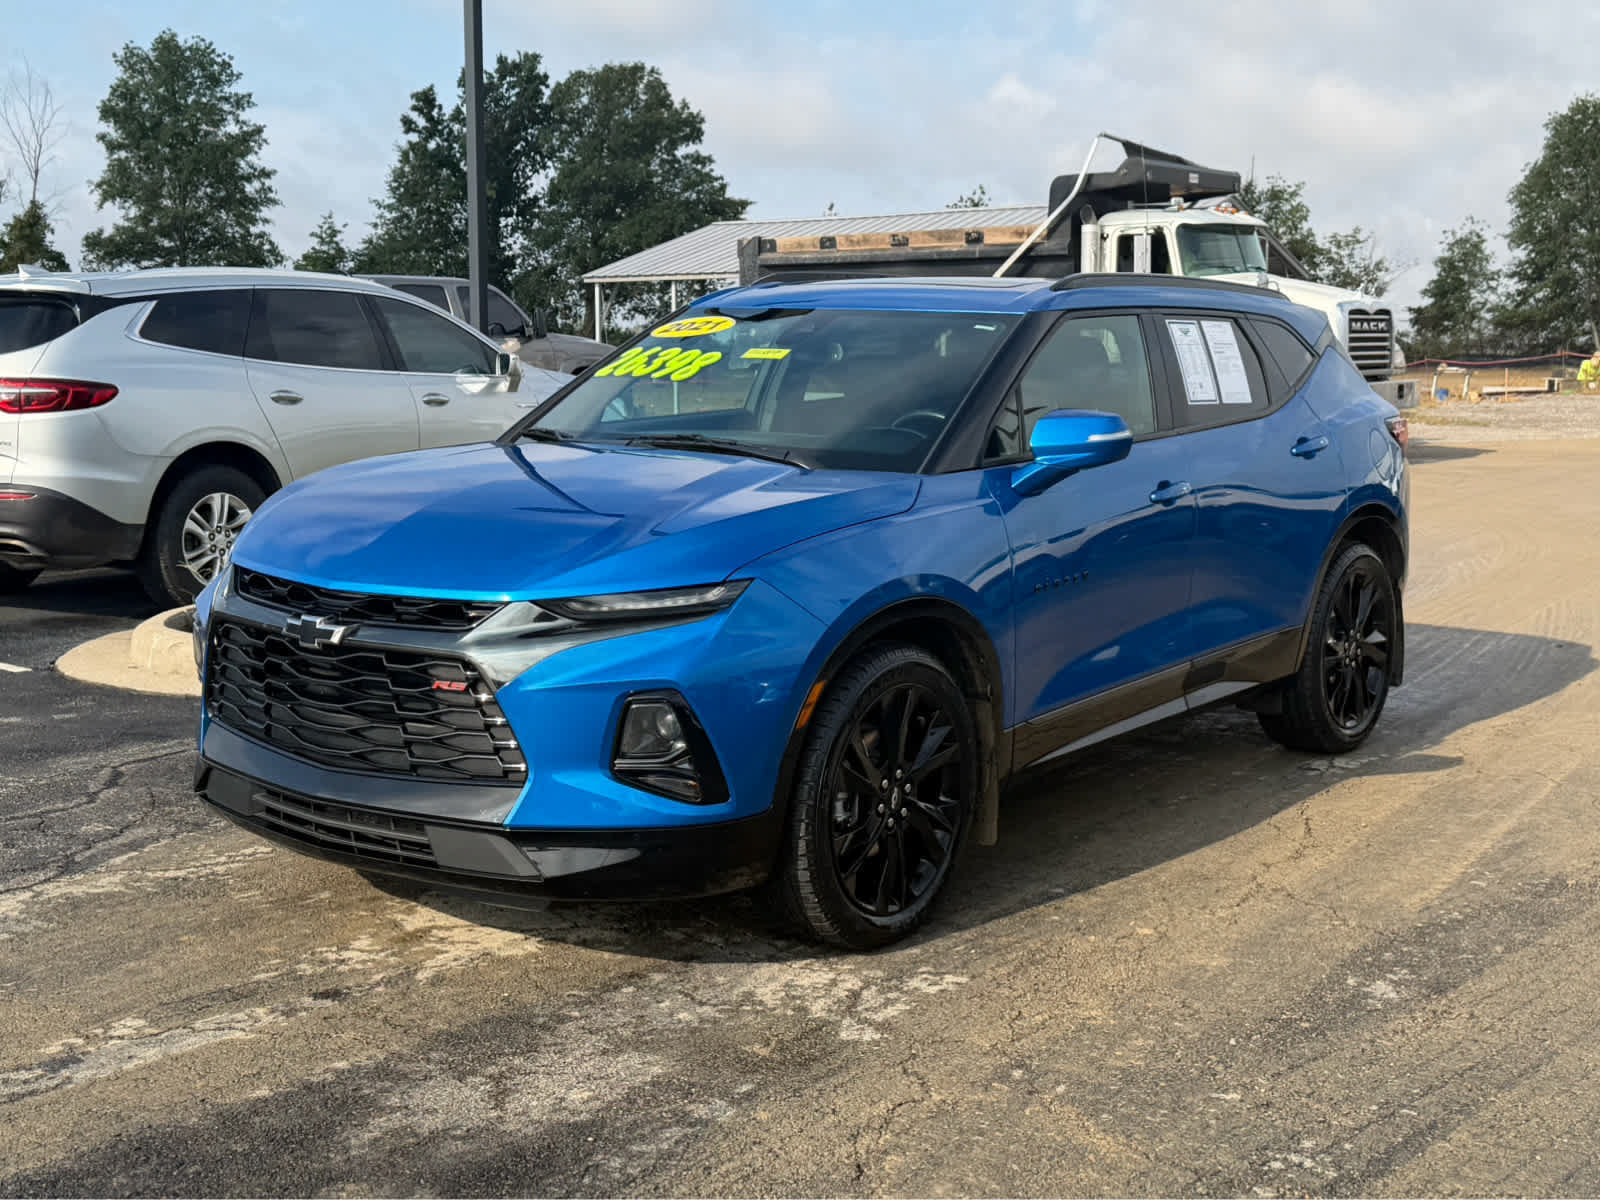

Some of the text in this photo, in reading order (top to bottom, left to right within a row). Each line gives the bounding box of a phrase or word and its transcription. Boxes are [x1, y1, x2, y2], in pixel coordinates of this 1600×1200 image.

[656, 320, 729, 335] 2021
[1351, 321, 1388, 331] MACK
[594, 346, 722, 381] 26398
[432, 680, 468, 692] RS
